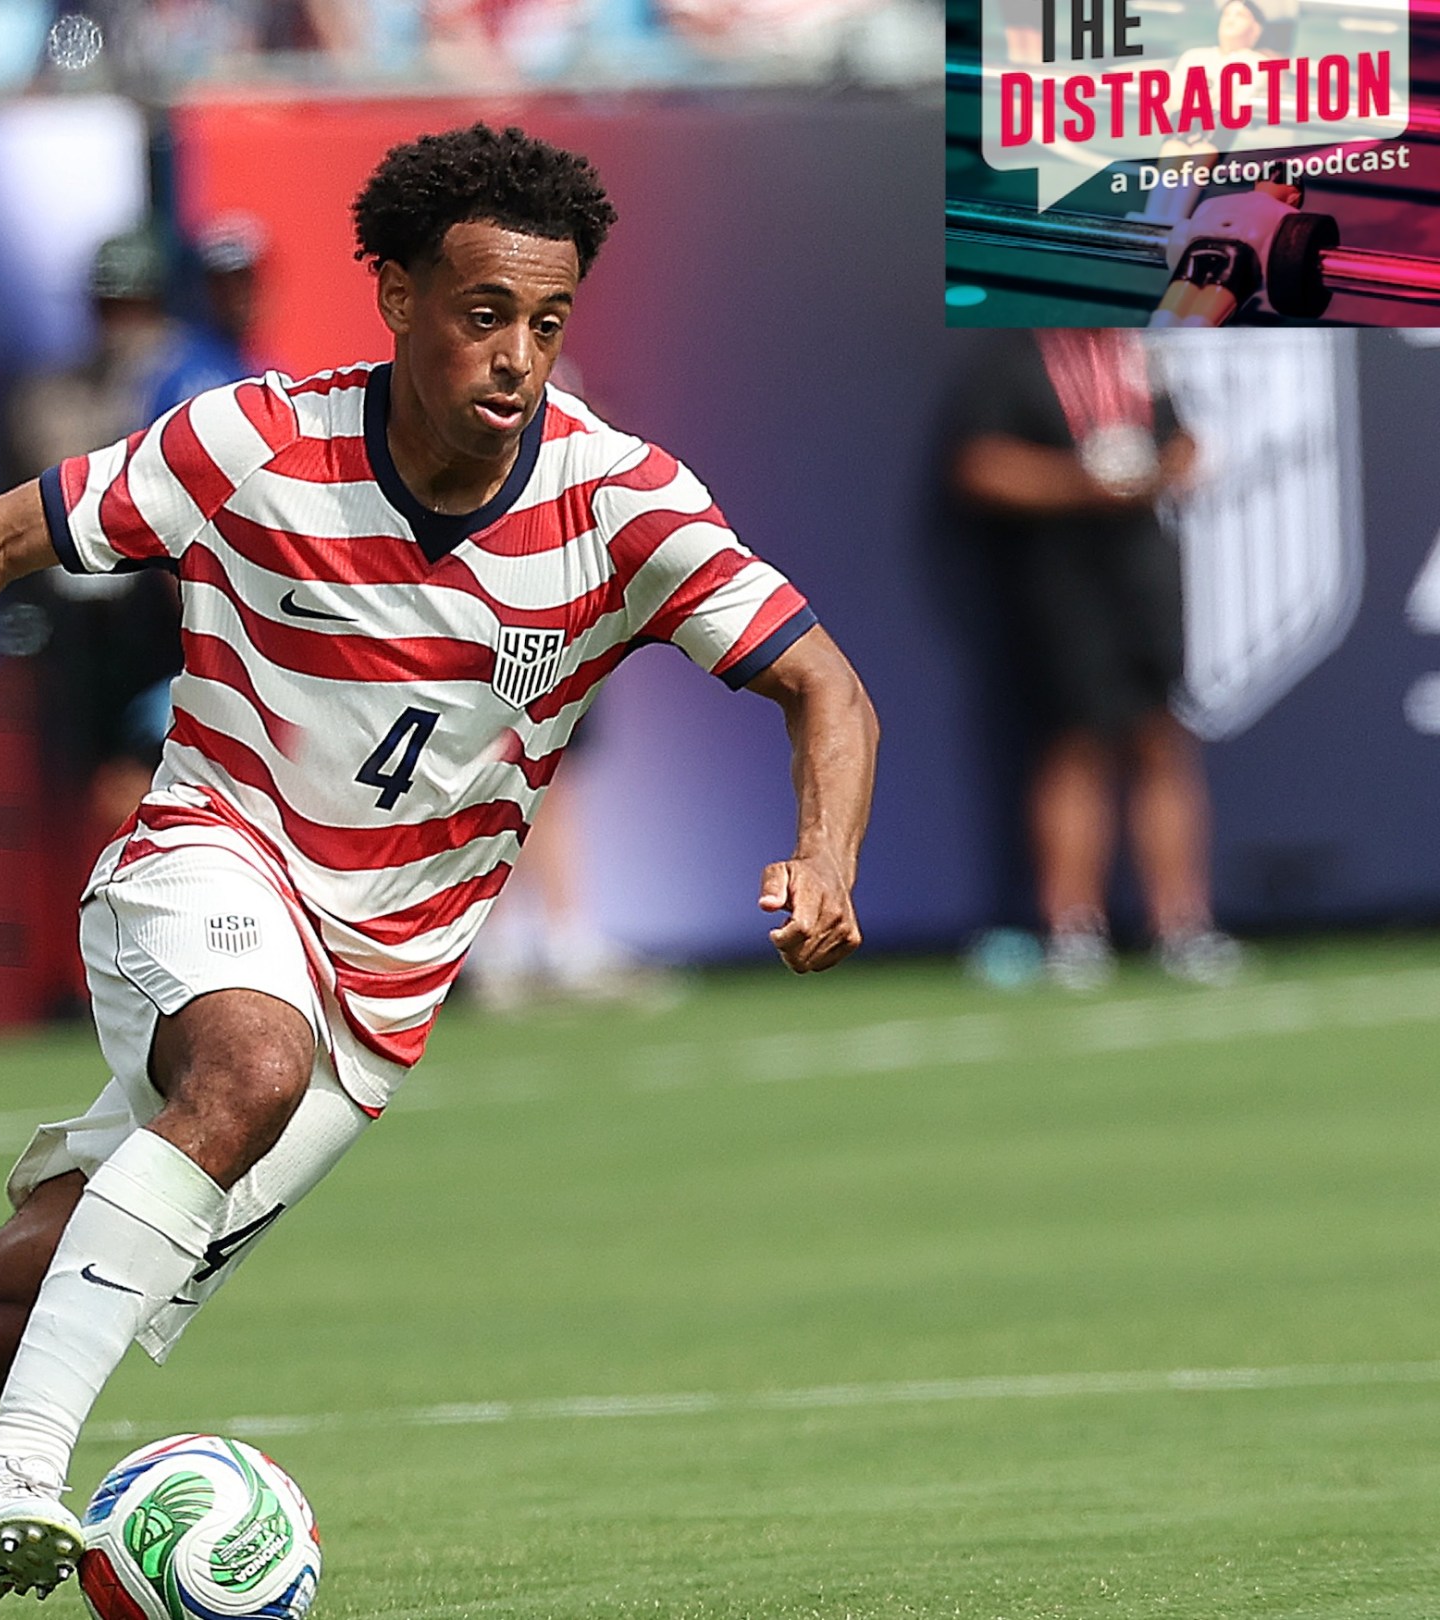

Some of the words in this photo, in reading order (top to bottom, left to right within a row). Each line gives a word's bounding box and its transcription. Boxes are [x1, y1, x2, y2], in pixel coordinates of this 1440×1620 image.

[503, 631, 560, 665] USA
[353, 705, 441, 812] 4
[210, 914, 256, 931] USA
[192, 1202, 287, 1284] 4
